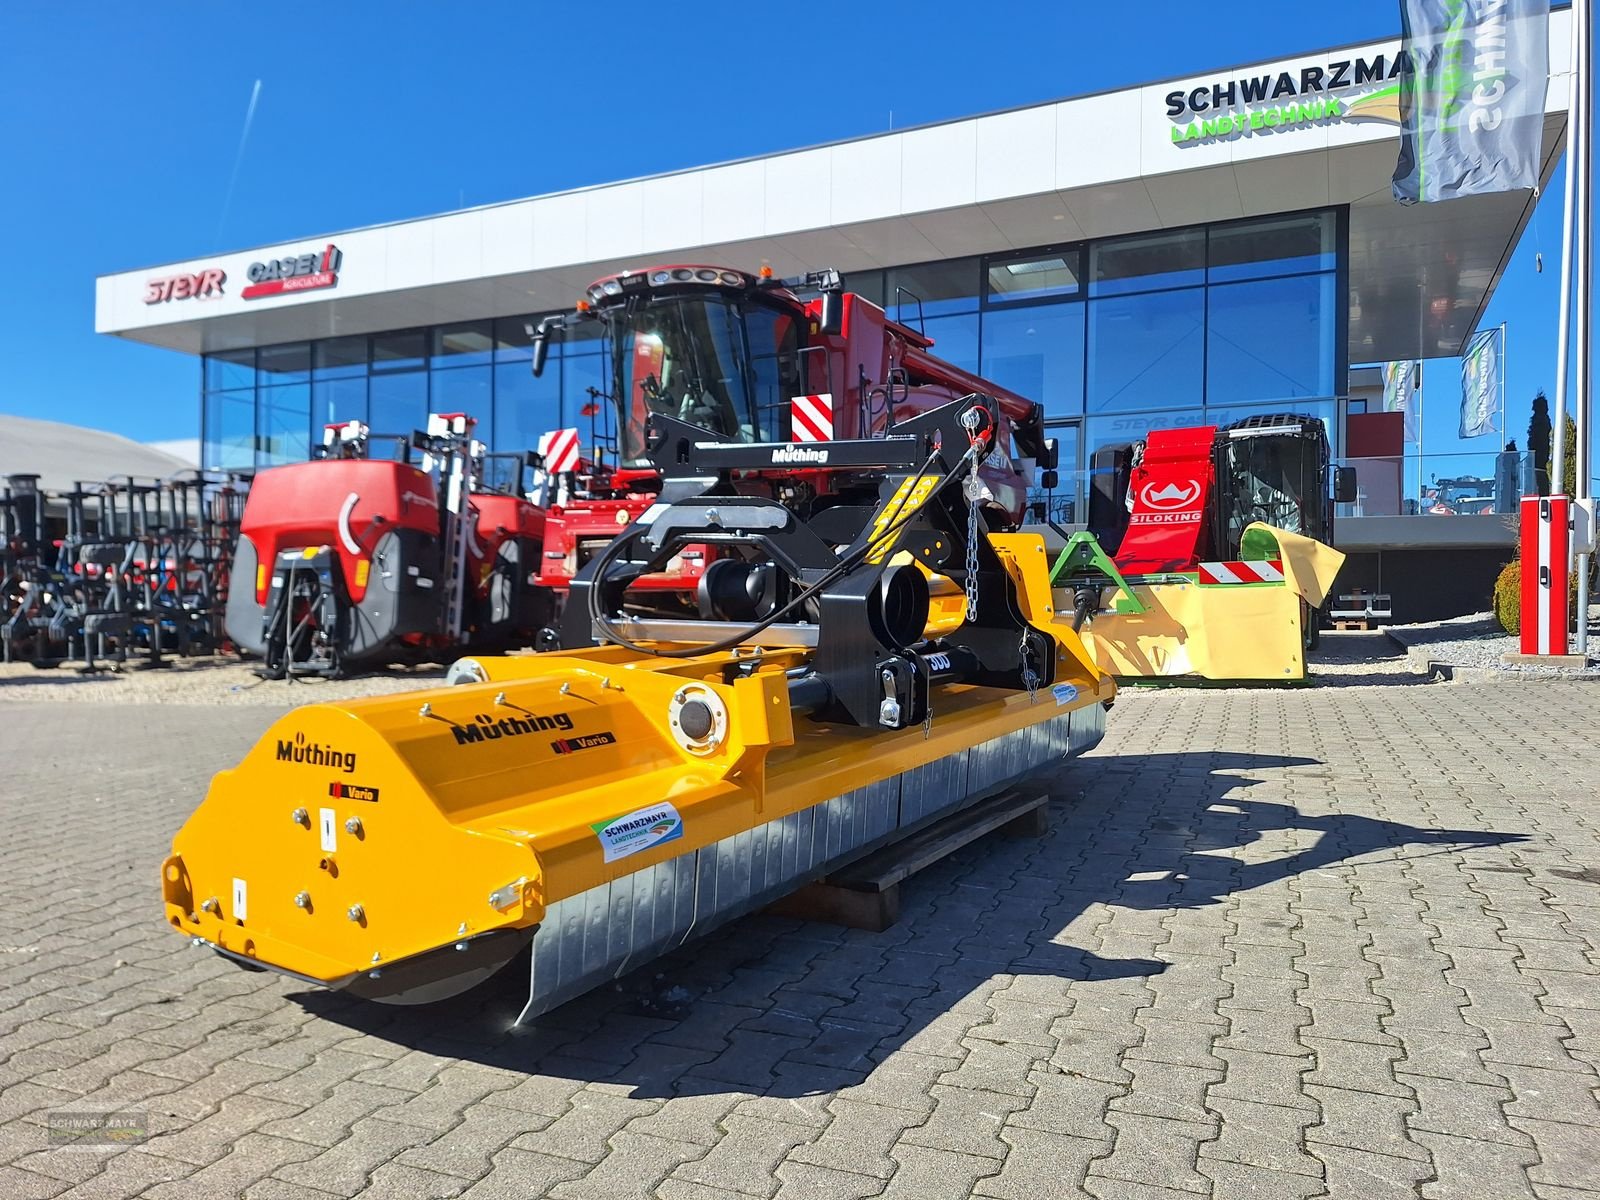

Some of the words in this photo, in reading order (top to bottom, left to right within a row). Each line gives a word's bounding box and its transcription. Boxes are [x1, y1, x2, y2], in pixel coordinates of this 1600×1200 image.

[1170, 97, 1343, 143] LANDTECHNIK
[247, 253, 316, 283] CASE
[144, 268, 226, 305] STEYR
[281, 272, 333, 291] AGRICULTURE
[1111, 416, 1169, 431] STEYR
[771, 444, 829, 464] Müthing
[1130, 512, 1201, 523] SILOKING
[450, 702, 574, 745] Müthing
[576, 735, 609, 748] Vario
[276, 731, 356, 773] Müthing
[347, 786, 374, 801] Vario
[604, 811, 668, 838] SCHWARZMAYR
[610, 828, 649, 845] LANDTECHNIK
